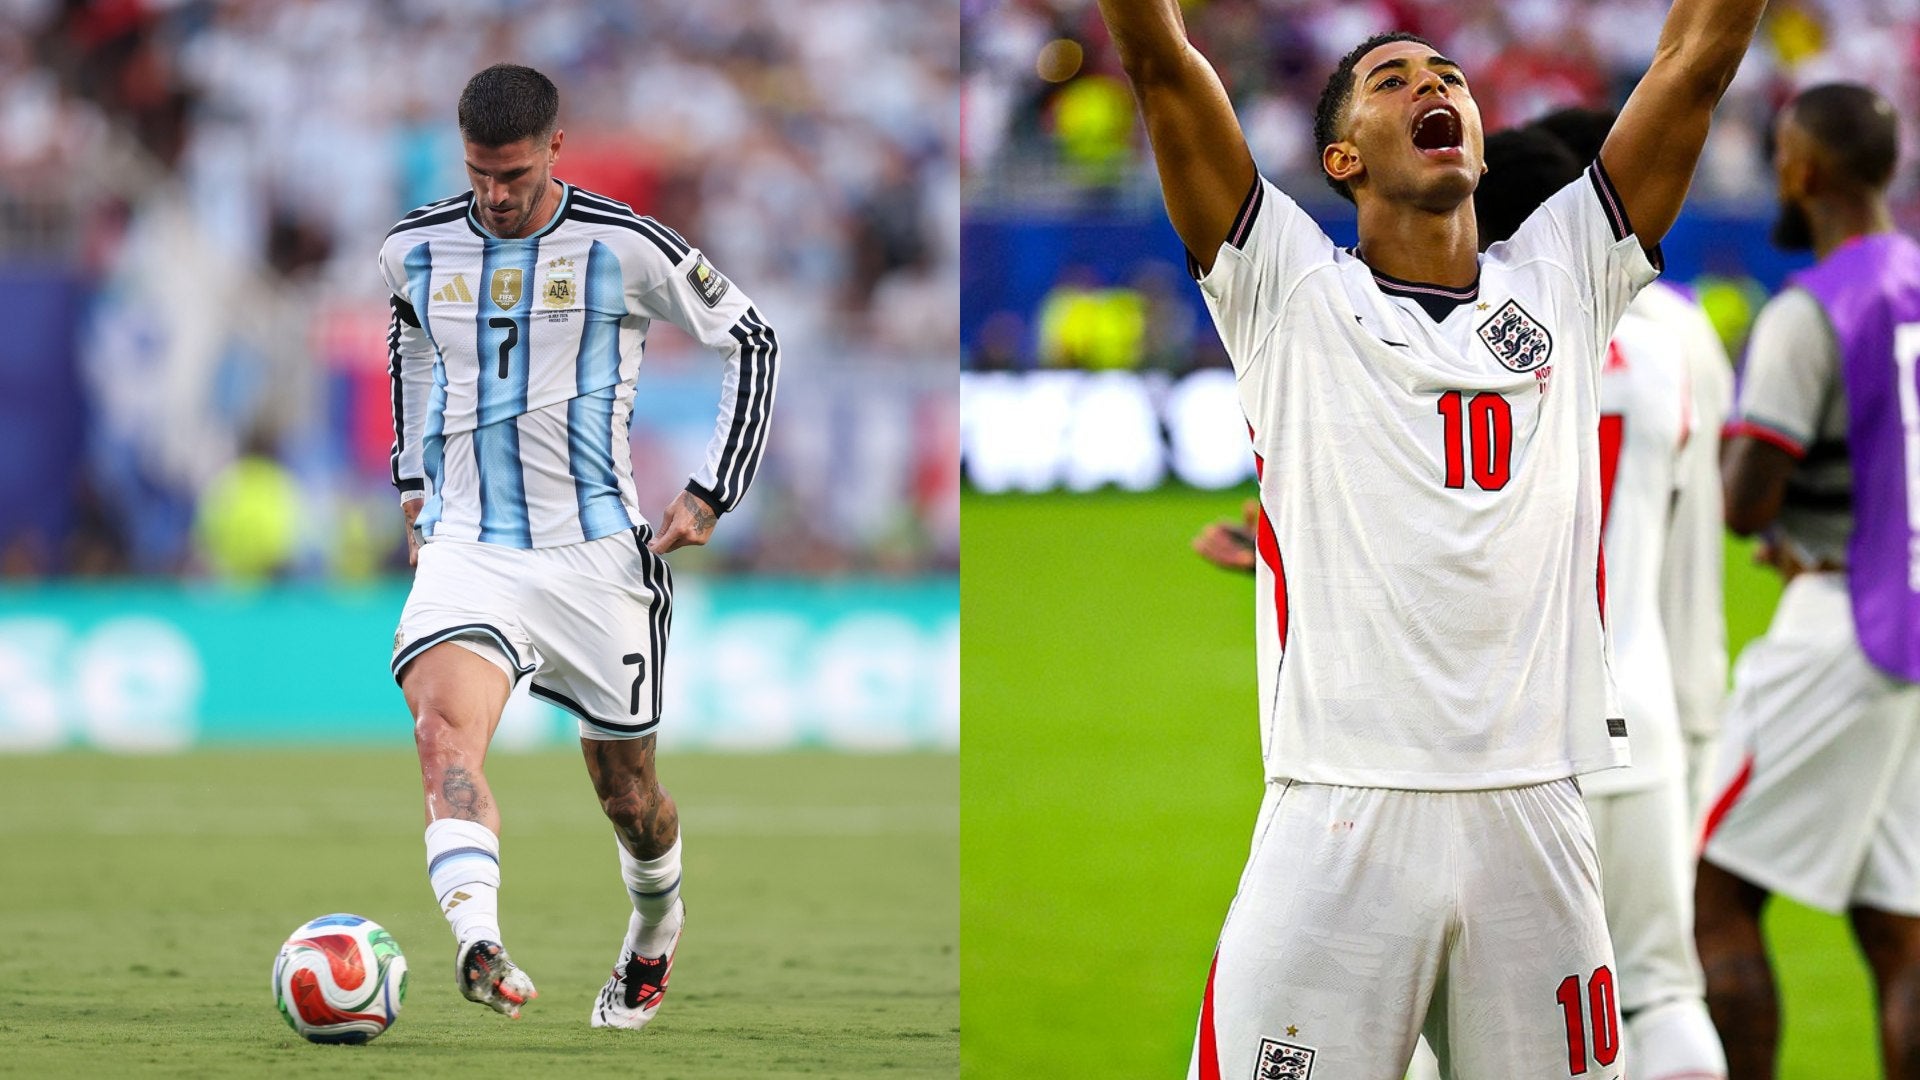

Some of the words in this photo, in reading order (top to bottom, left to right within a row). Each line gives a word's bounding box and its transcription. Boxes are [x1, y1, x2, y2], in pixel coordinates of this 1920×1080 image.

[549, 280, 569, 299] AFA
[489, 317, 518, 379] 7
[1438, 390, 1512, 491] 10
[622, 653, 645, 715] 7
[1556, 965, 1619, 1076] 10
